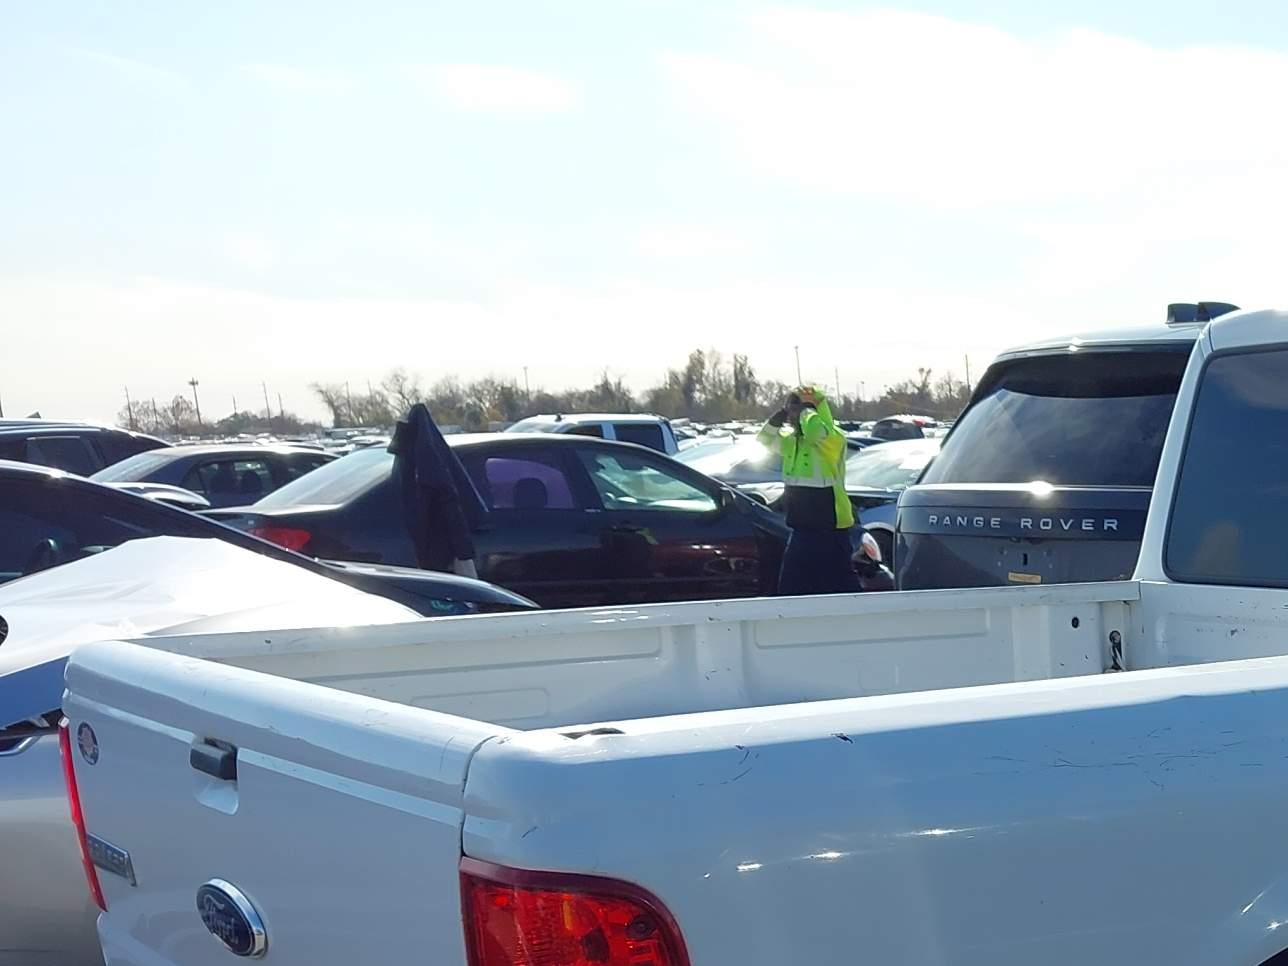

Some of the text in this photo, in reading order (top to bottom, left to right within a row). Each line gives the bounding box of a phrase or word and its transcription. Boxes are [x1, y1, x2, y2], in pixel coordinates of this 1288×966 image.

[928, 515, 1119, 531] RANGE ROVER
[203, 893, 240, 945] Ford
